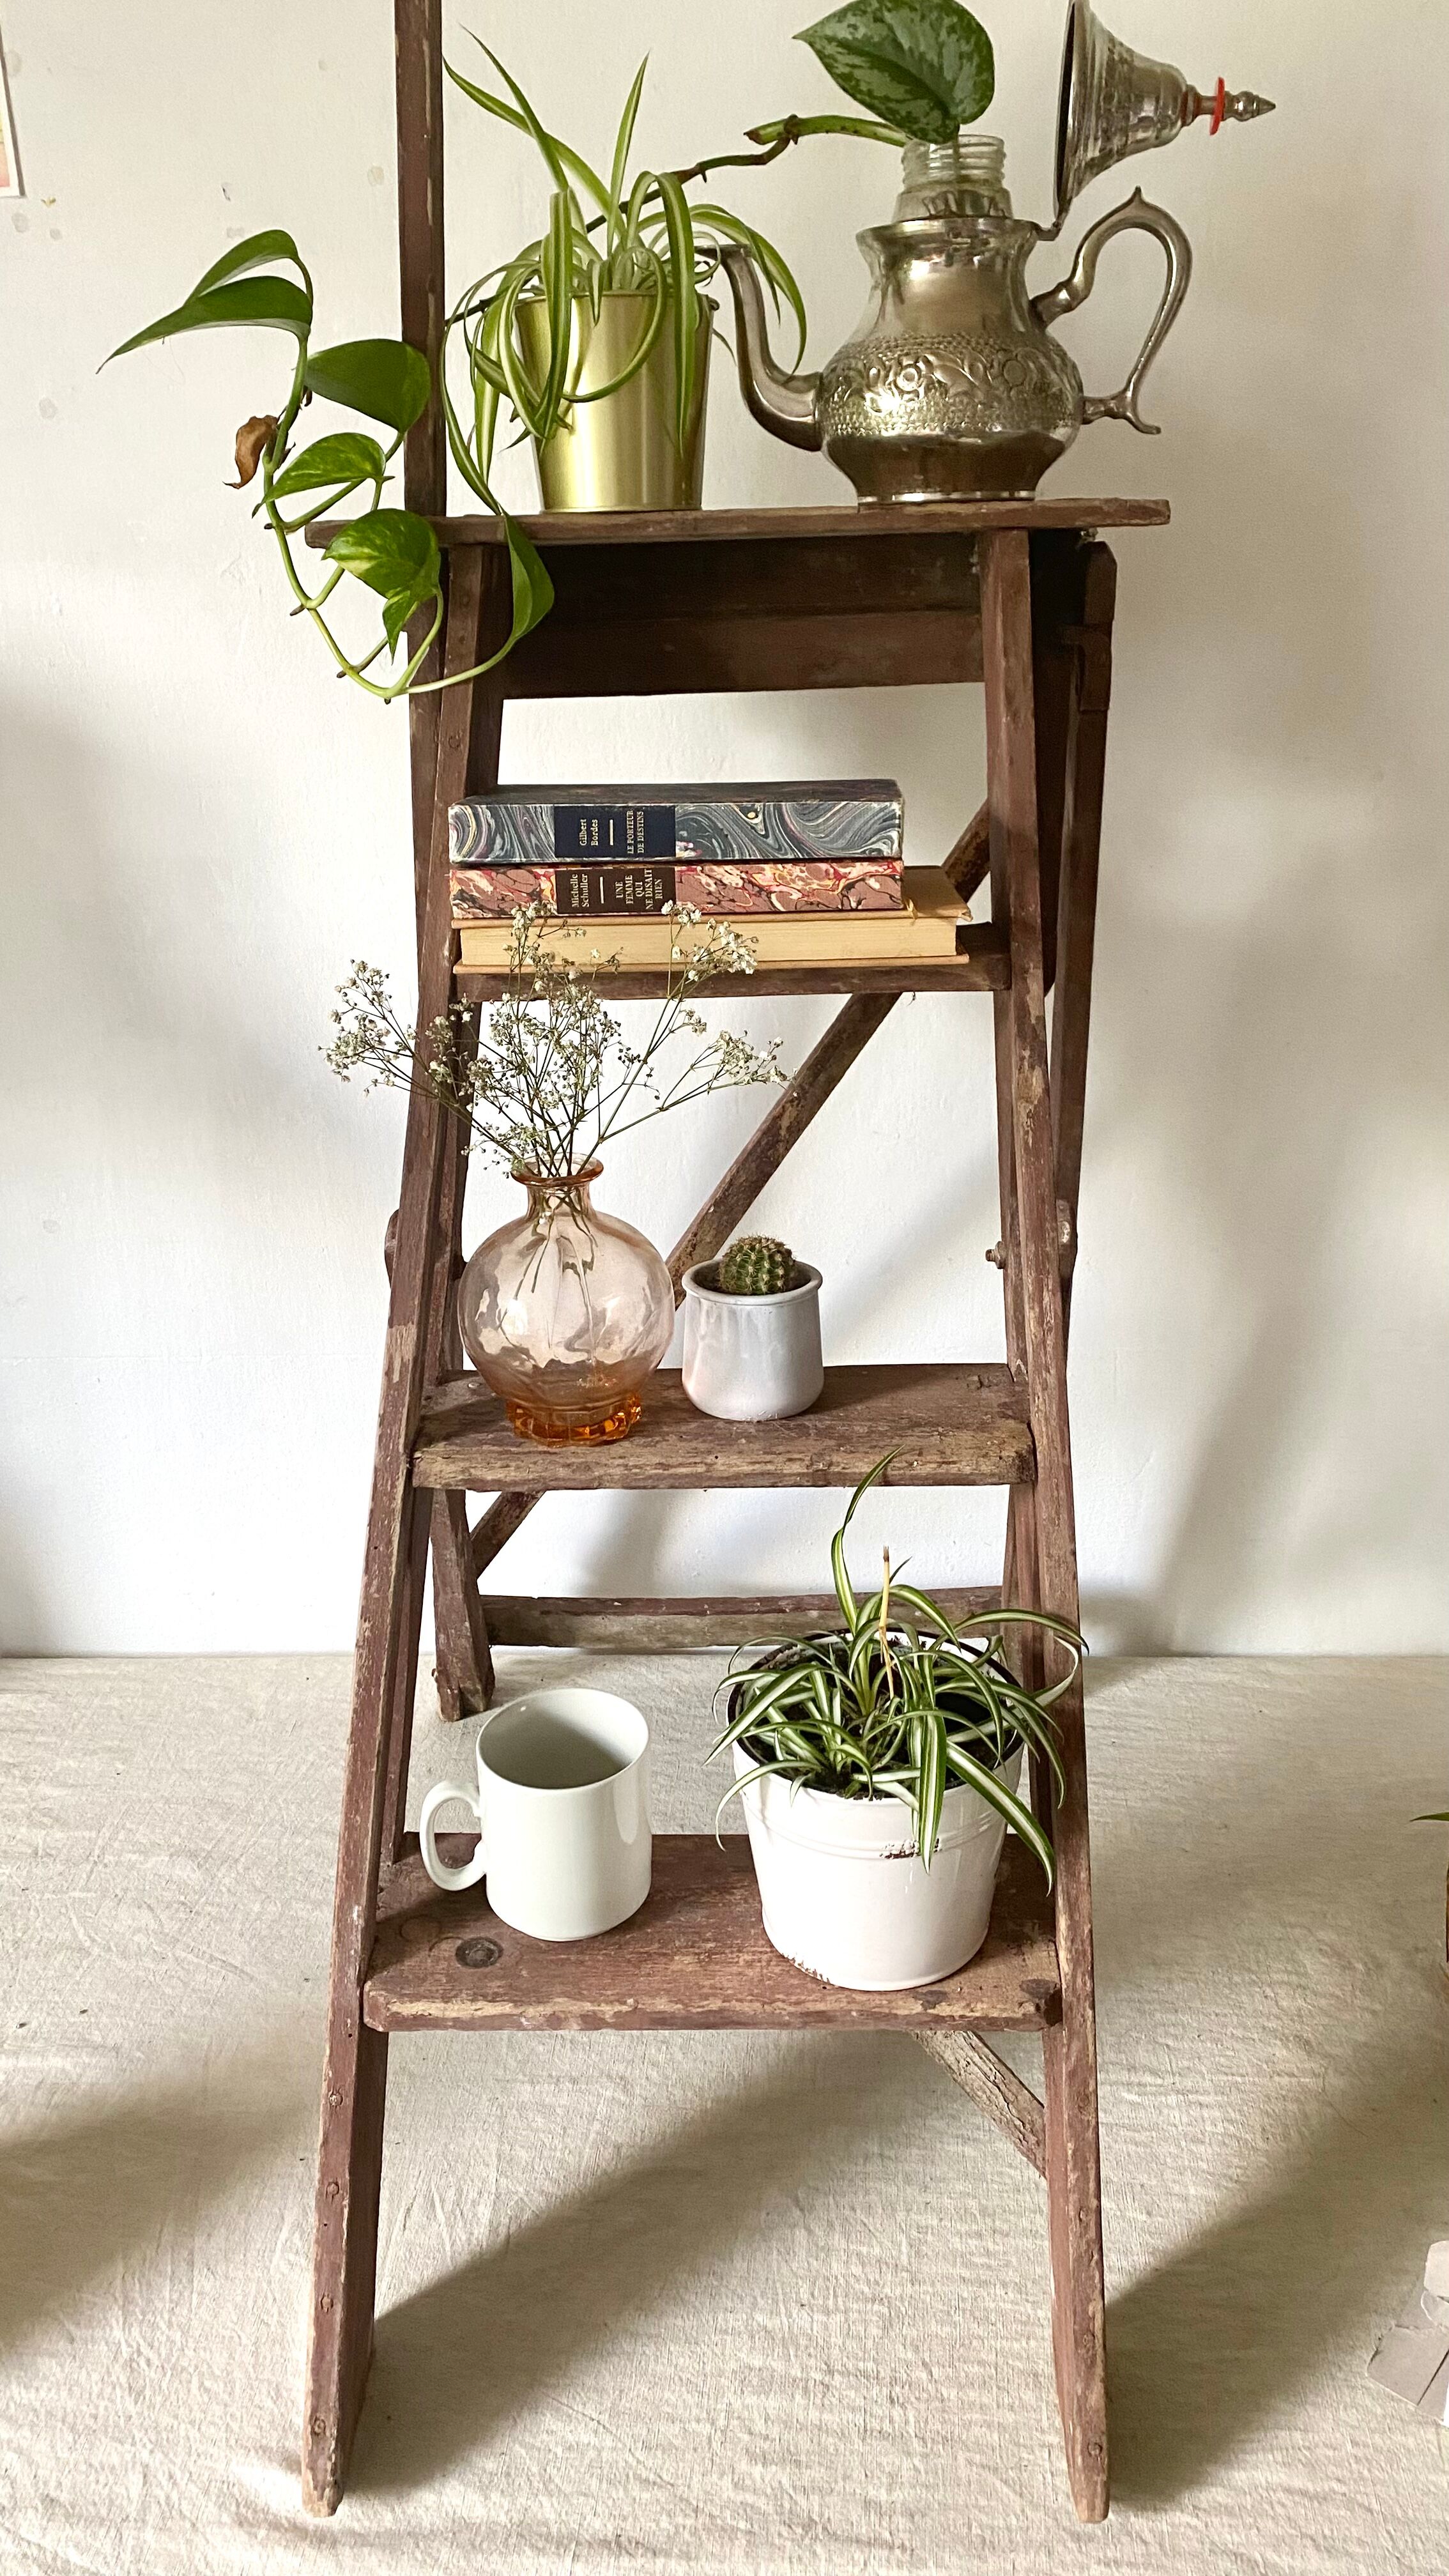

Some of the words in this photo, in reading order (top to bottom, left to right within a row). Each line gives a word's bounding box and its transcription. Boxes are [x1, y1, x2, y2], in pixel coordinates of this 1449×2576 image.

[590, 819, 599, 846] Bordes
[627, 845, 634, 854] LE
[637, 843, 645, 854] DE
[570, 874, 579, 907] Michelle
[580, 874, 590, 907] Schuller
[615, 881, 624, 898] UNE
[625, 875, 634, 904] FEMME
[635, 882, 645, 897] QUI
[644, 869, 653, 897] DISAIT
[645, 898, 654, 910] NE
